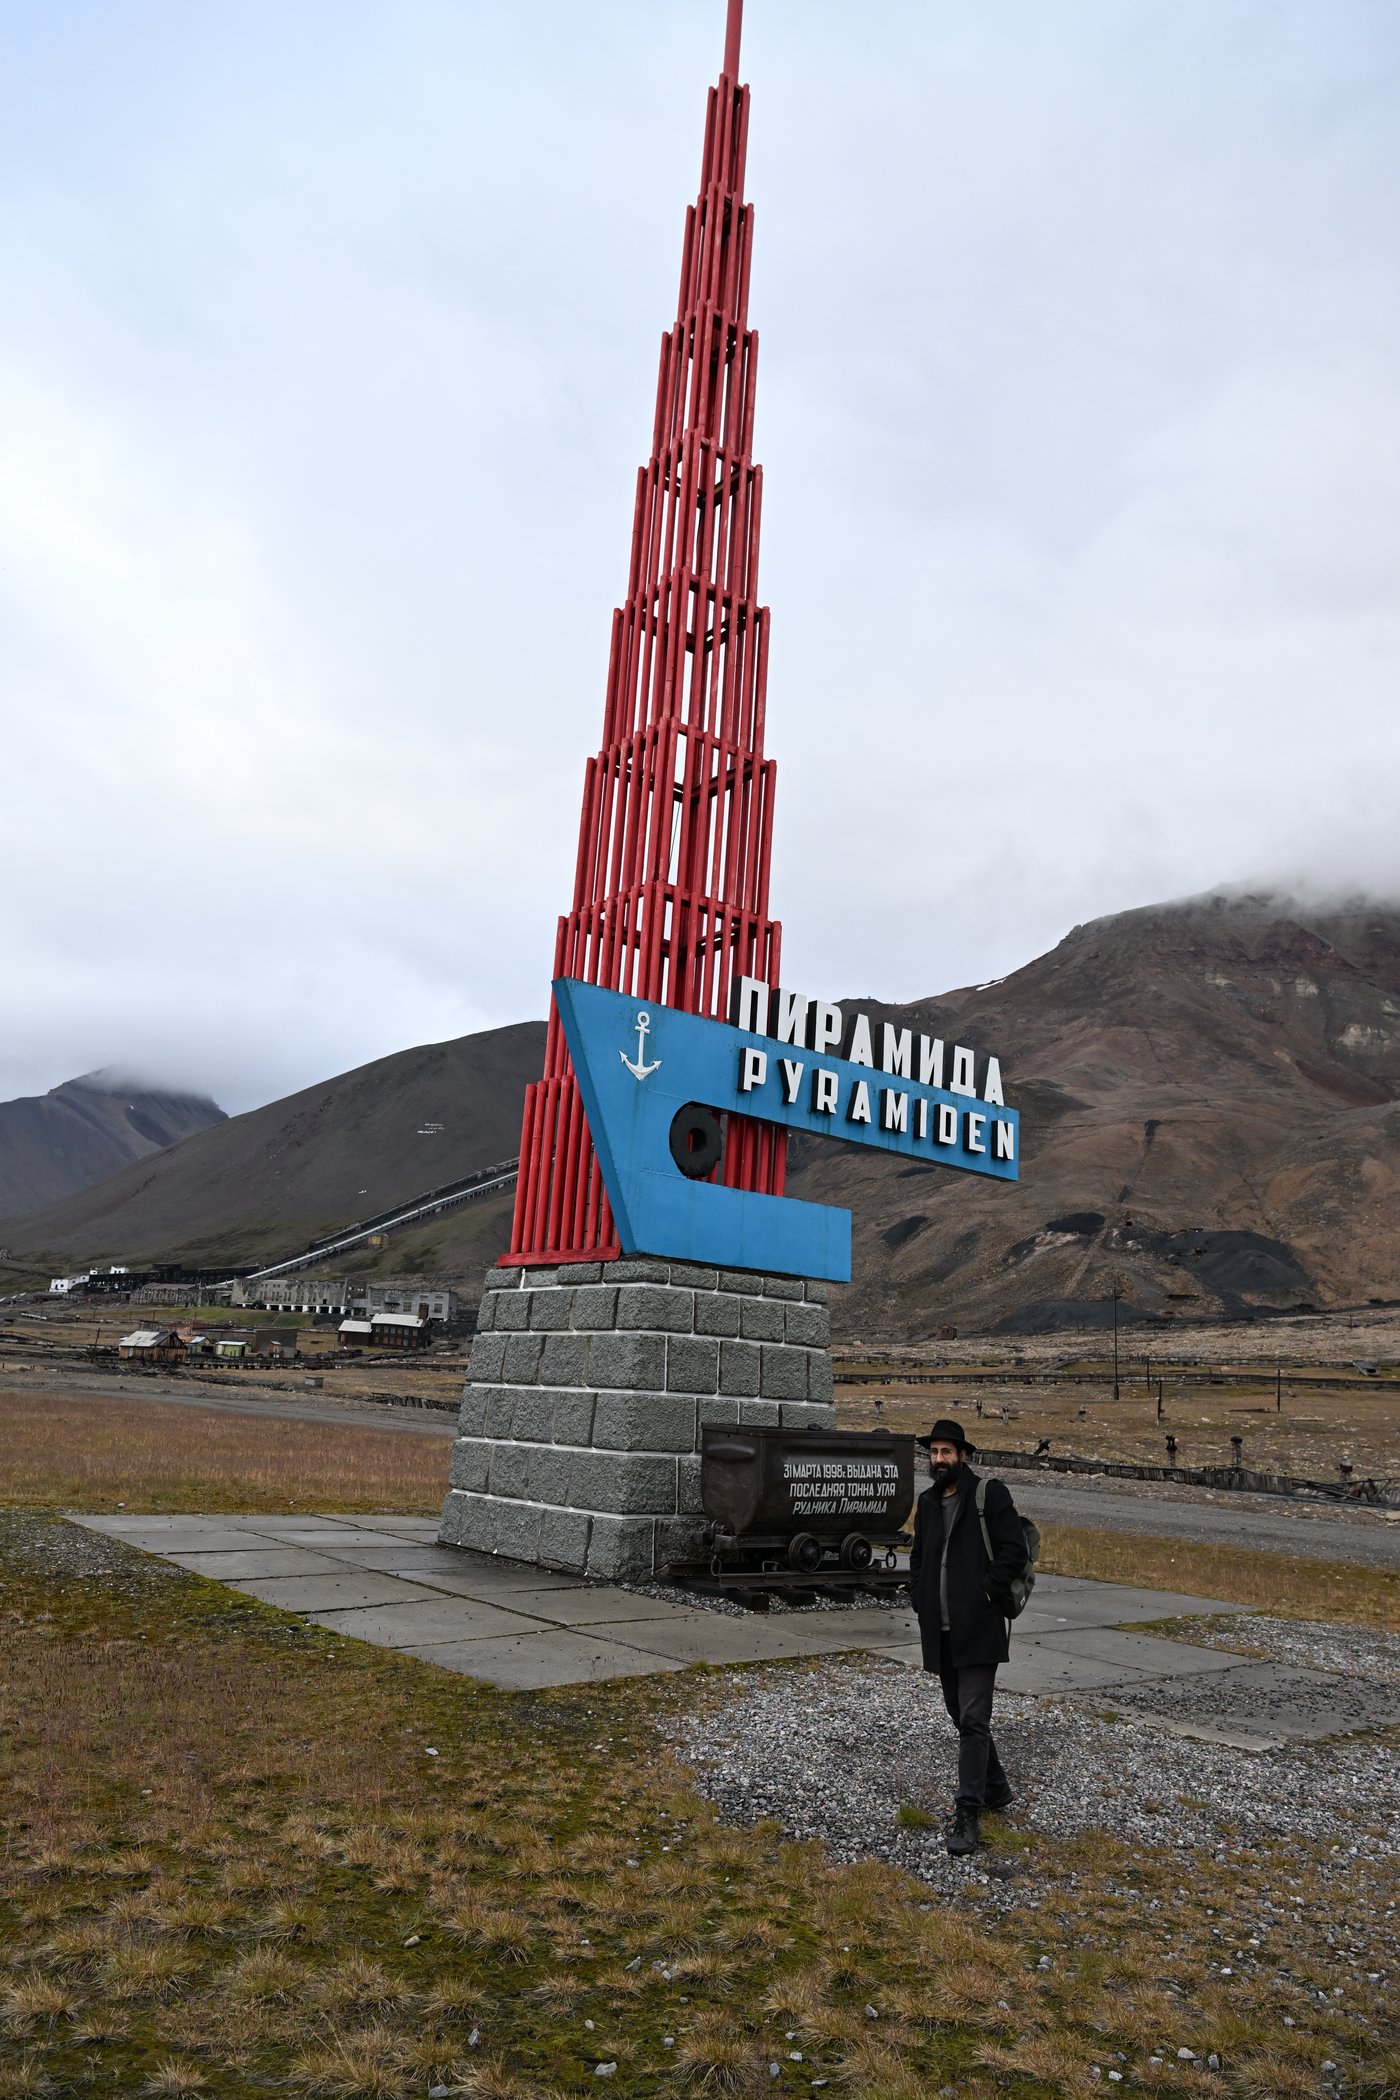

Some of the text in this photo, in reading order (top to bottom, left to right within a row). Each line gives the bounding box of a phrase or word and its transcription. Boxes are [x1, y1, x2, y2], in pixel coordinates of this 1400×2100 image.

[735, 975, 1005, 1107] ПИРАМИДА
[741, 1047, 1014, 1160] PYRAMIDEN
[789, 1483, 895, 1497] ПОСЛЕДНЯЯ ТОННА УГЛЯ
[792, 1464, 821, 1478] МАРТА
[847, 1464, 882, 1478] ВЫДАНА
[884, 1464, 899, 1479] ЭТА
